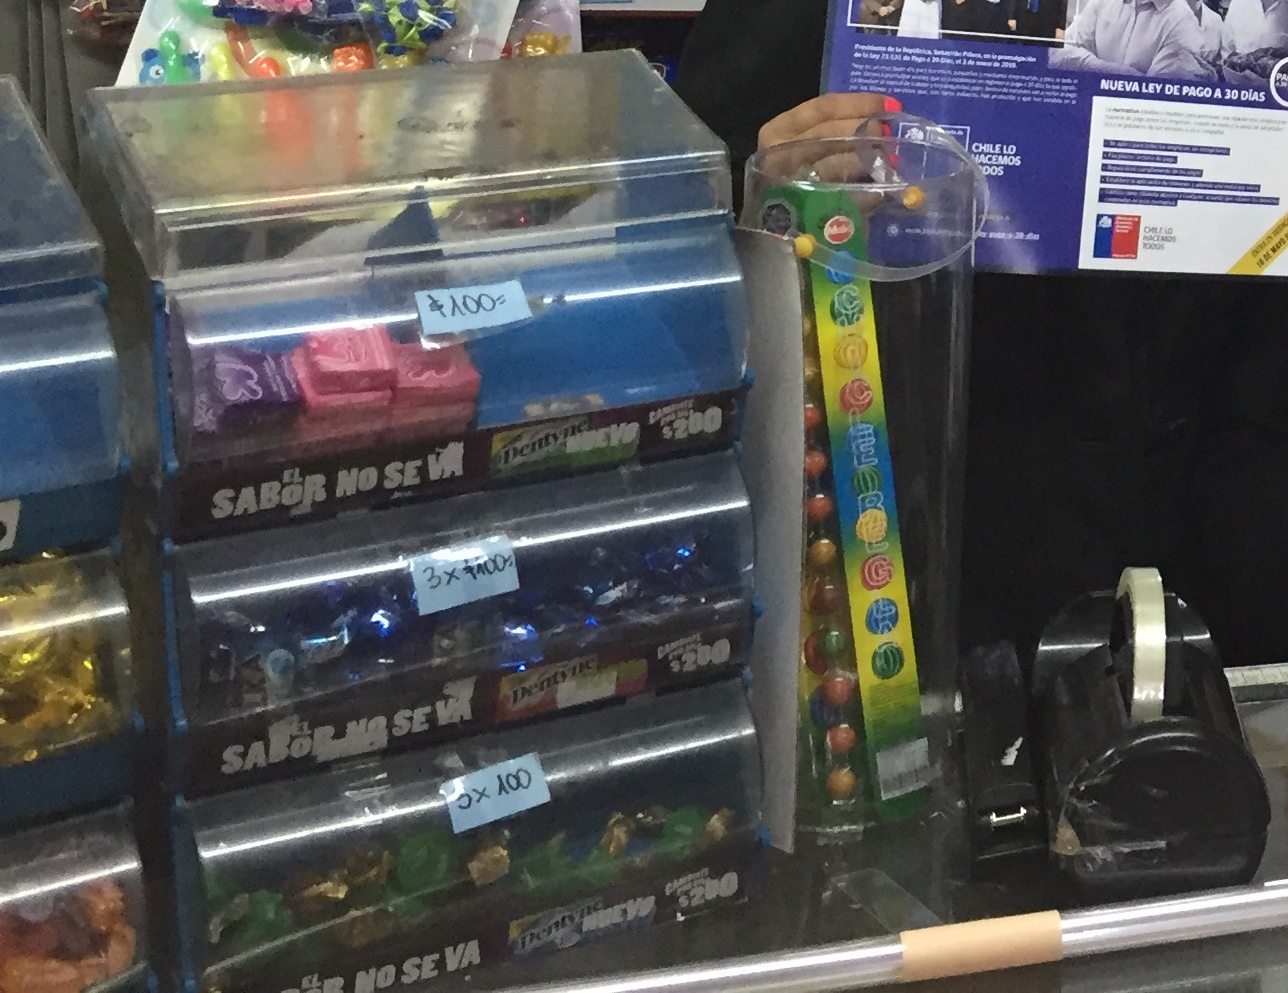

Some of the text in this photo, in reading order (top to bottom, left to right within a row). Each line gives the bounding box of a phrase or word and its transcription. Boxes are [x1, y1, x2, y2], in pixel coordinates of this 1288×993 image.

[1100, 79, 1266, 102] NUEVA LEY DE PAGO A 30 DÍAS
[972, 143, 1016, 155] CHILE LO
[335, 466, 378, 498] NO
[383, 459, 423, 489] SE
[392, 706, 432, 737] SE
[401, 953, 440, 984] SE
[444, 939, 480, 972] VA
